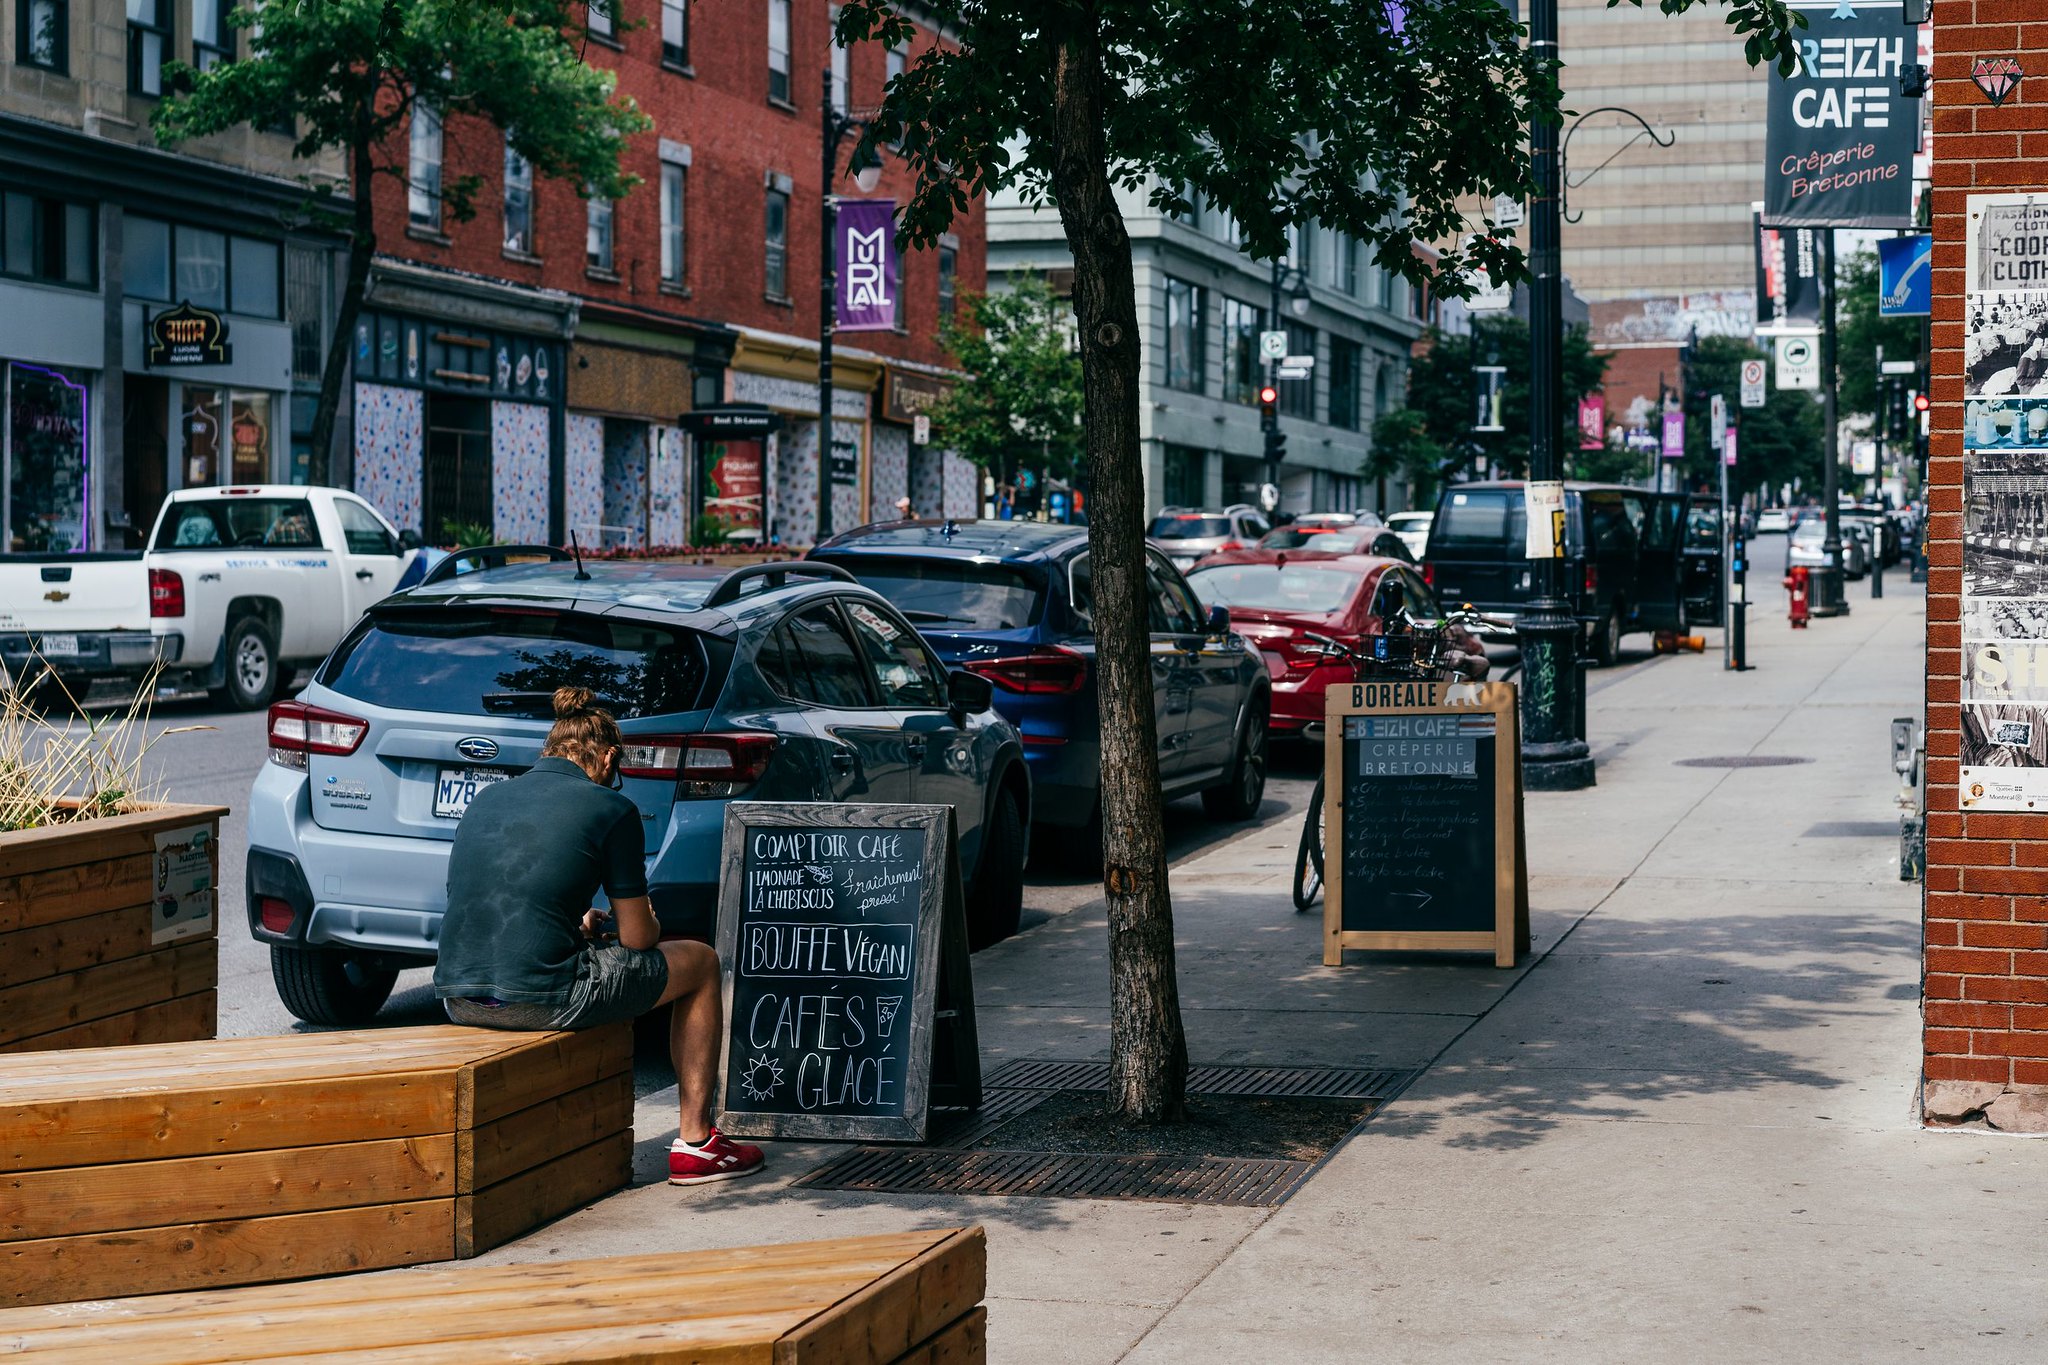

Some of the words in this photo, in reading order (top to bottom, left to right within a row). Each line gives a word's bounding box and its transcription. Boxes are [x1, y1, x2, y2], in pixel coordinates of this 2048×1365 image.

[1792, 87, 1890, 128] CAFE
[1780, 142, 1875, 175] Crêperie
[1791, 163, 1899, 198] Bretonne
[2014, 221, 2048, 231] CLOT
[276, 559, 328, 568] TECHNIQUE
[1352, 682, 1437, 708] BORÉALE
[1414, 718, 1456, 737] CAFE
[1372, 741, 1464, 757] CRÊPERIE
[473, 773, 504, 782] Québec
[1365, 761, 1471, 775] BRETONNE
[754, 833, 850, 861] COMPTOIR
[857, 833, 903, 859] CAFÉ
[767, 888, 835, 910] L'HIBISCUS
[751, 926, 838, 972] BOUFFE
[843, 928, 906, 975] VÉGAN
[750, 984, 866, 1050] CAFÉS
[796, 1043, 897, 1110] GLACÉ
